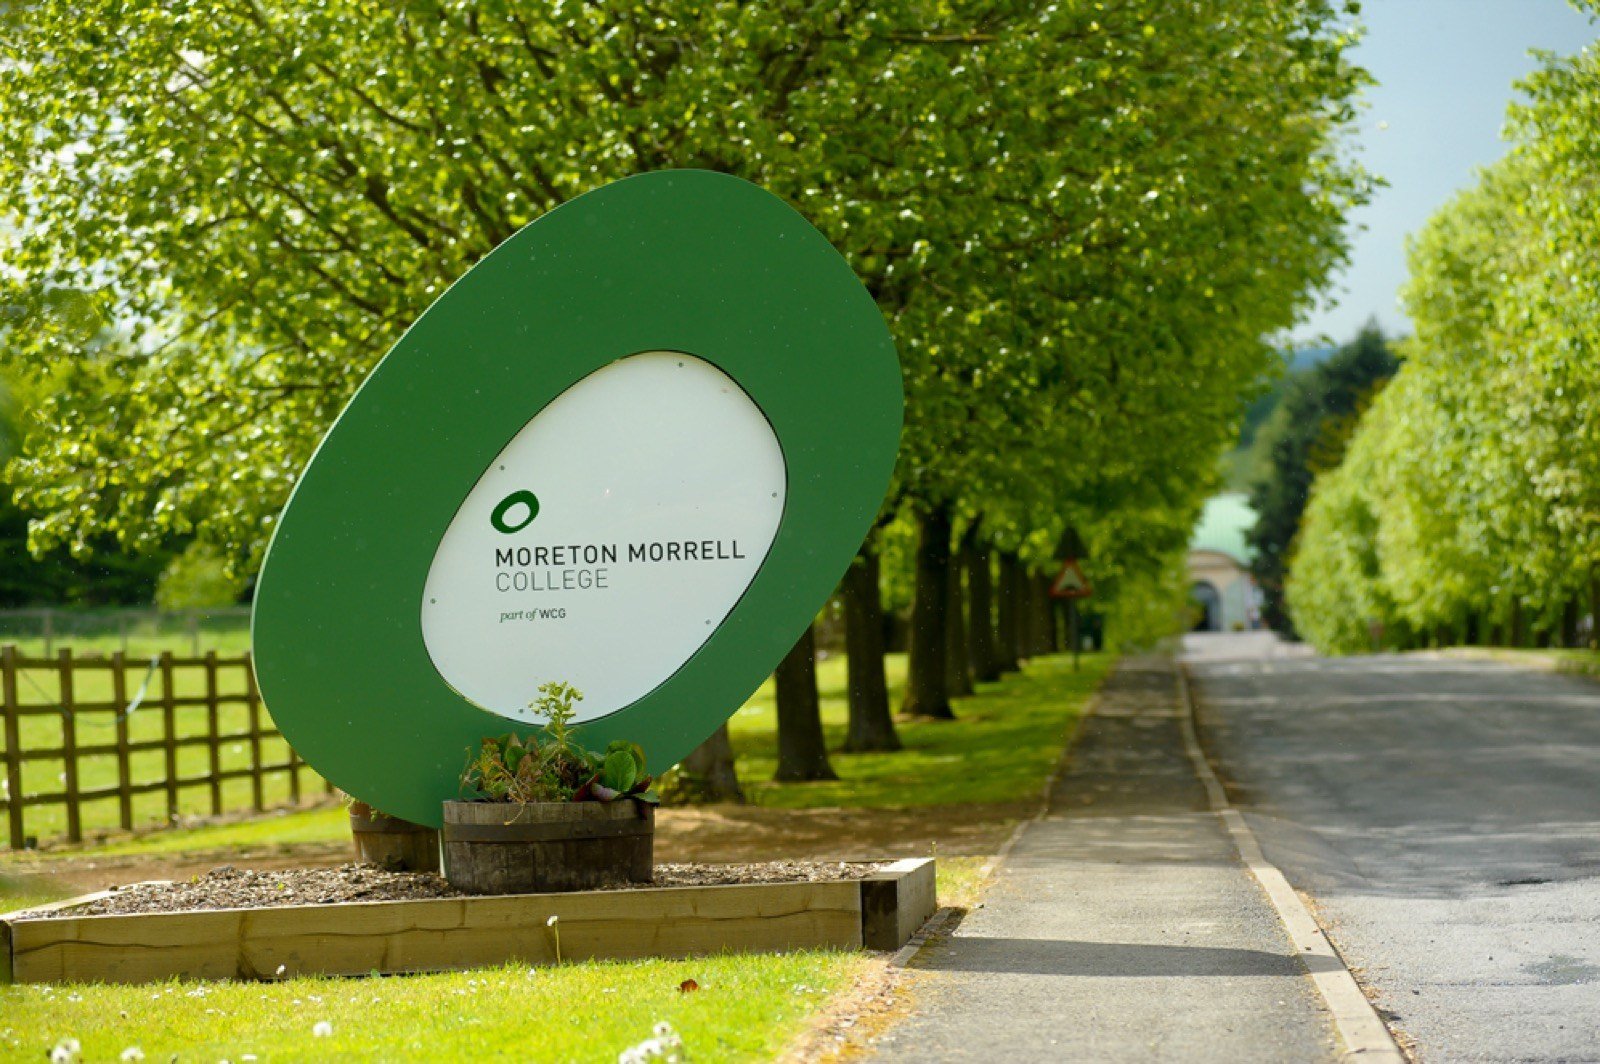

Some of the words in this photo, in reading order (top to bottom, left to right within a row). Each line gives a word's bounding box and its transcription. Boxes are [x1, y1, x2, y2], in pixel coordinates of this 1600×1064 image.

[495, 544, 618, 568] MORETON
[628, 539, 746, 563] MORRELL
[495, 568, 609, 592] COLLEGE
[499, 609, 524, 624] part
[525, 607, 539, 622] of
[539, 607, 567, 620] WCG
